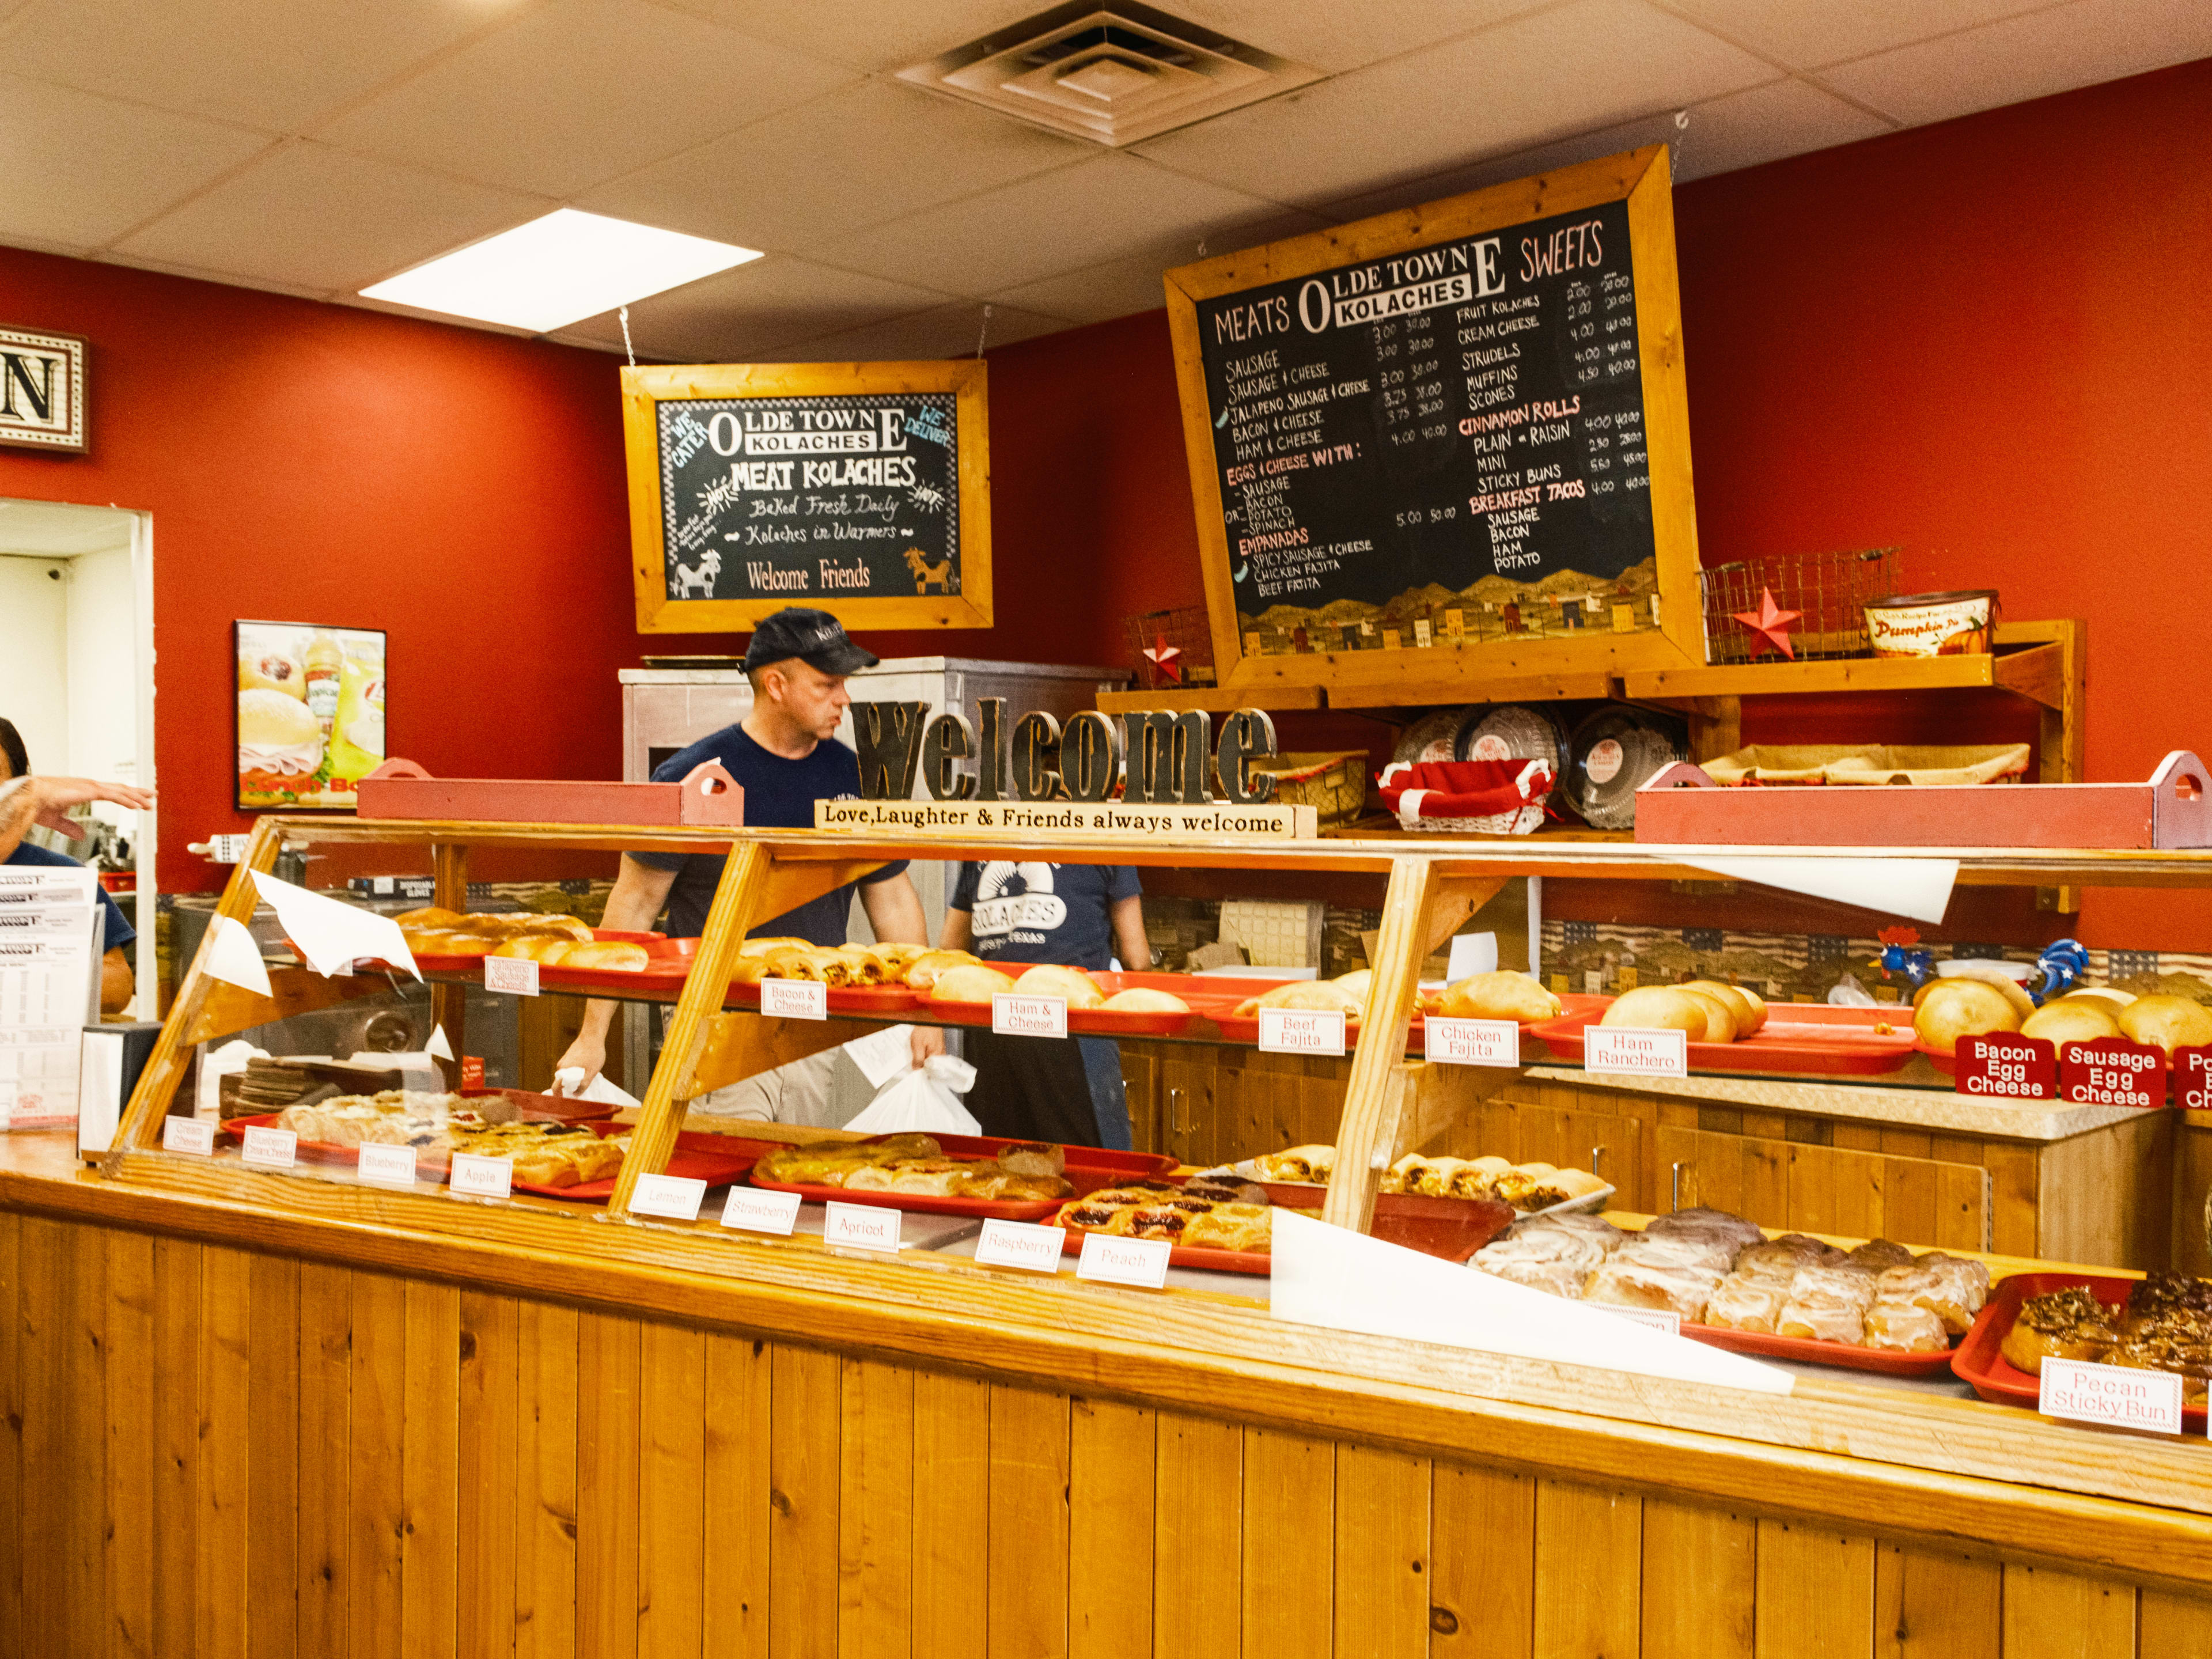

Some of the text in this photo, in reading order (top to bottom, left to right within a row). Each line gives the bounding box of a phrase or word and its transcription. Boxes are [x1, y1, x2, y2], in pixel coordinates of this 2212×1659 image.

[1520, 220, 1603, 283] SWEETS
[1298, 237, 1505, 334] OLDE TOWNE
[1340, 279, 1465, 324] KOLACHES
[1456, 294, 1540, 324] FRUIT KOLACHES
[1215, 295, 1290, 345] MEATS
[1457, 315, 1541, 345] CREAM CHEESE
[1225, 349, 1281, 384] SAUSAGE
[1461, 342, 1521, 372] STRUDELS
[1228, 373, 1279, 406] SAUSAGE
[1290, 362, 1331, 385] CHEESE
[1465, 365, 1518, 392] MUFFINS
[1230, 396, 1285, 426] JALAPENO
[1287, 387, 1331, 412] SAUSAGE
[1338, 377, 1371, 398] CHEESE
[1468, 384, 1516, 411] SCONES
[671, 410, 696, 439] WE
[920, 405, 945, 426] WE
[1232, 422, 1268, 444] BACON
[1282, 409, 1325, 431] CHEESE
[1458, 395, 1581, 437] CINNAMON ROLLS
[708, 408, 907, 456] OLDE TOWNE
[751, 433, 872, 452] KOLACHES
[904, 416, 950, 448] DELIVER
[1474, 419, 1571, 456] PLAIN RAISIN
[671, 422, 709, 468] CATER
[1236, 440, 1264, 462] HAM
[1277, 429, 1324, 452] CHEESE
[730, 456, 916, 491] MEAT KOLACHES
[1226, 463, 1257, 487] EGGS
[1265, 452, 1310, 476] CHEESE
[1476, 453, 1507, 473] MINI
[1242, 476, 1290, 501] SAUSAGE
[1477, 463, 1562, 494] STICKY BUNS
[854, 493, 900, 522] Daily
[1245, 493, 1283, 513] BACON
[1468, 479, 1586, 516] BREAKFAST TACOS
[1225, 508, 1240, 525] OR
[1249, 517, 1296, 536] SPINACH
[1487, 506, 1540, 529] SAUSAGE
[744, 521, 897, 546] Kolaches in Warmers
[1238, 527, 1309, 557] EMPANADAS
[1490, 524, 1531, 544] BACON
[1252, 552, 1282, 570] SPICY
[1282, 545, 1326, 566] SAUSAGE
[1334, 539, 1374, 557] CHEESE
[1492, 543, 1522, 558] HAM
[1494, 551, 1541, 574] POTATO
[747, 557, 871, 592] Welcome Friends
[1253, 559, 1342, 584] CHICKEN FAJITA
[1257, 576, 1321, 599] BEEF FAJITA
[1874, 620, 1944, 638] Pumpkin
[330, 778, 358, 793] Bo
[977, 808, 993, 826] &
[1003, 808, 1084, 828] Friends
[1093, 810, 1173, 834] always
[1181, 812, 1284, 834] welcome
[772, 986, 816, 1001] Bacon &
[774, 999, 813, 1013] Cheese
[1010, 1001, 1051, 1016] Ham &
[1008, 1015, 1054, 1030] Cheese
[1283, 1017, 1316, 1031] Beef
[1441, 1023, 1502, 1043] Chicken
[1281, 1032, 1321, 1048] Fajita
[1449, 1040, 1493, 1059] Fajita
[1613, 1035, 1653, 1051] Ham
[1975, 1041, 2037, 1062] Bacon
[1598, 1050, 1675, 1068] Ranchero
[1987, 1059, 2026, 1083] Egg
[2069, 1047, 2157, 1073] Sausage
[1967, 1076, 2044, 1097] Cheese
[2090, 1067, 2134, 1091] Egg
[2071, 1084, 2150, 1107] Cheese
[365, 1155, 410, 1173] Blueberry
[464, 1167, 497, 1184] Apple
[648, 1188, 687, 1206] Lemon
[732, 1200, 793, 1223] Strawberry
[839, 1217, 885, 1238] Apricot
[987, 1233, 1055, 1257] Raspberry
[1101, 1248, 1146, 1268] Peach
[2074, 1372, 2147, 1398] Pecan
